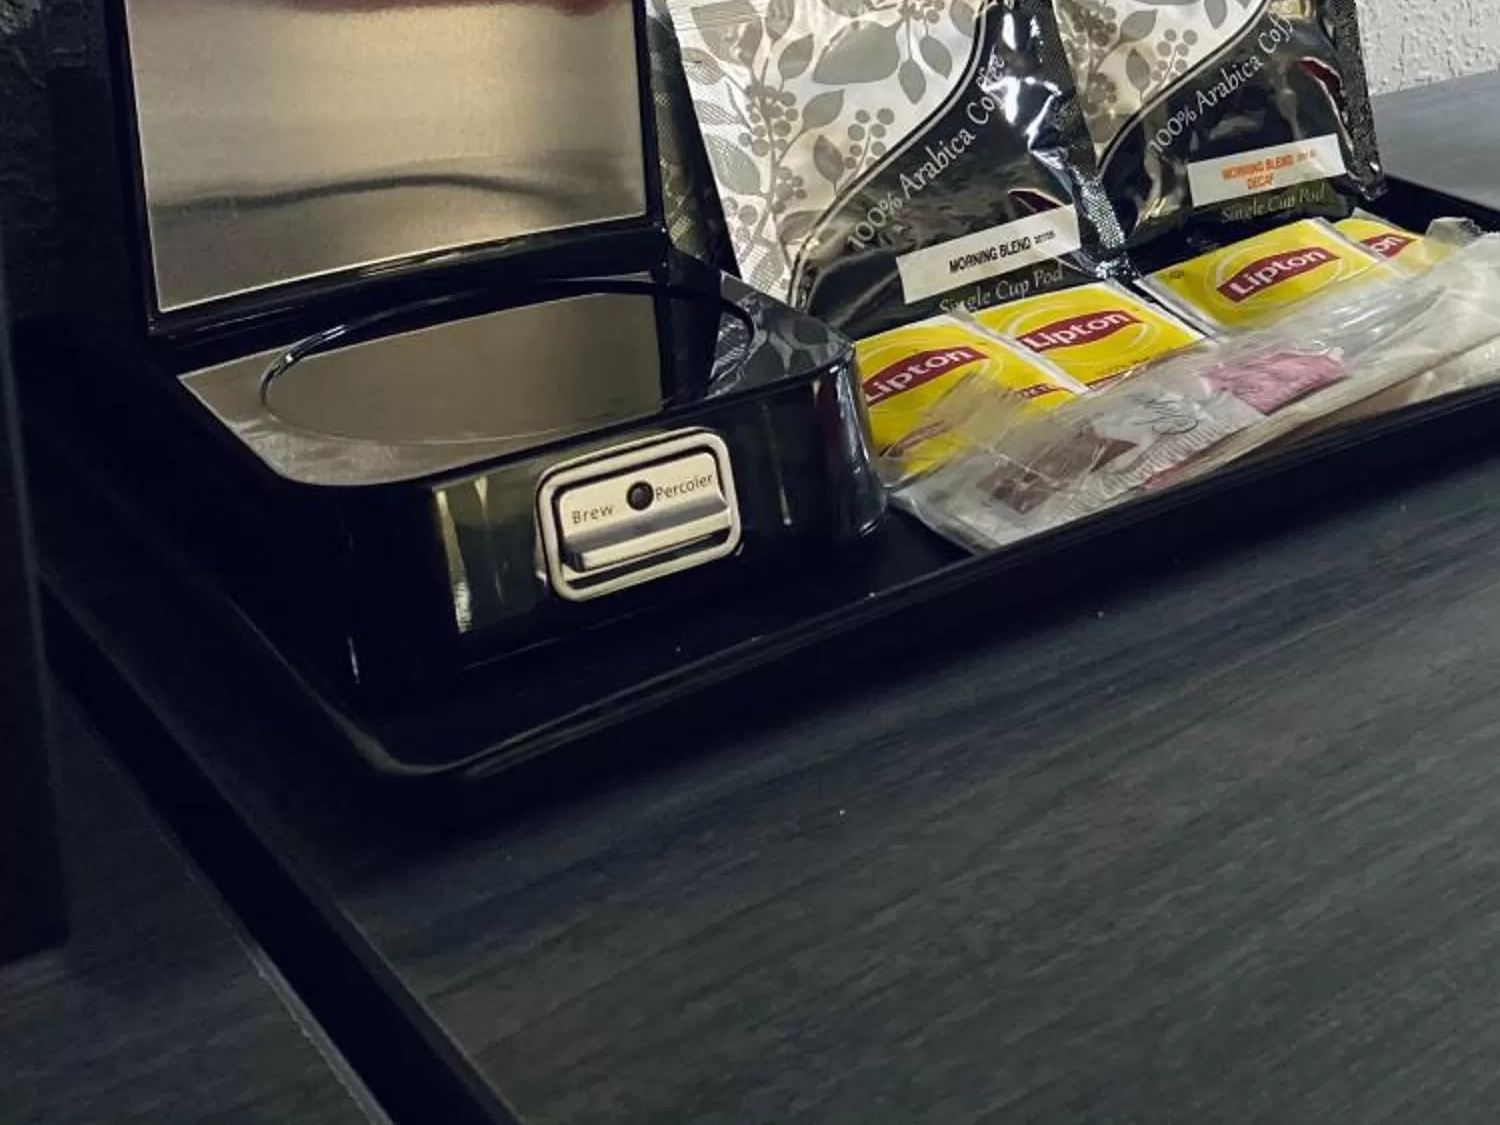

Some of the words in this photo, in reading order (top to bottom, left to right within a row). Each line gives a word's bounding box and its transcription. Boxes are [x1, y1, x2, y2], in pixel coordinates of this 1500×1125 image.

[1150, 104, 1198, 153] 100%
[1195, 56, 1264, 115] Arabica
[847, 190, 903, 251] 100%
[899, 127, 976, 200] Arabica
[1222, 161, 1264, 179] MORNING
[1265, 154, 1294, 169] BLEND
[949, 246, 998, 273] MORNING
[999, 236, 1031, 257] BLEND
[1229, 249, 1328, 296] Lipton
[996, 279, 1030, 299] Cup
[1034, 262, 1064, 288] Pod
[1022, 312, 1131, 351] Lipton
[865, 348, 974, 403] Lipton
[571, 504, 614, 525] Brew
[655, 474, 713, 501] Percoler
